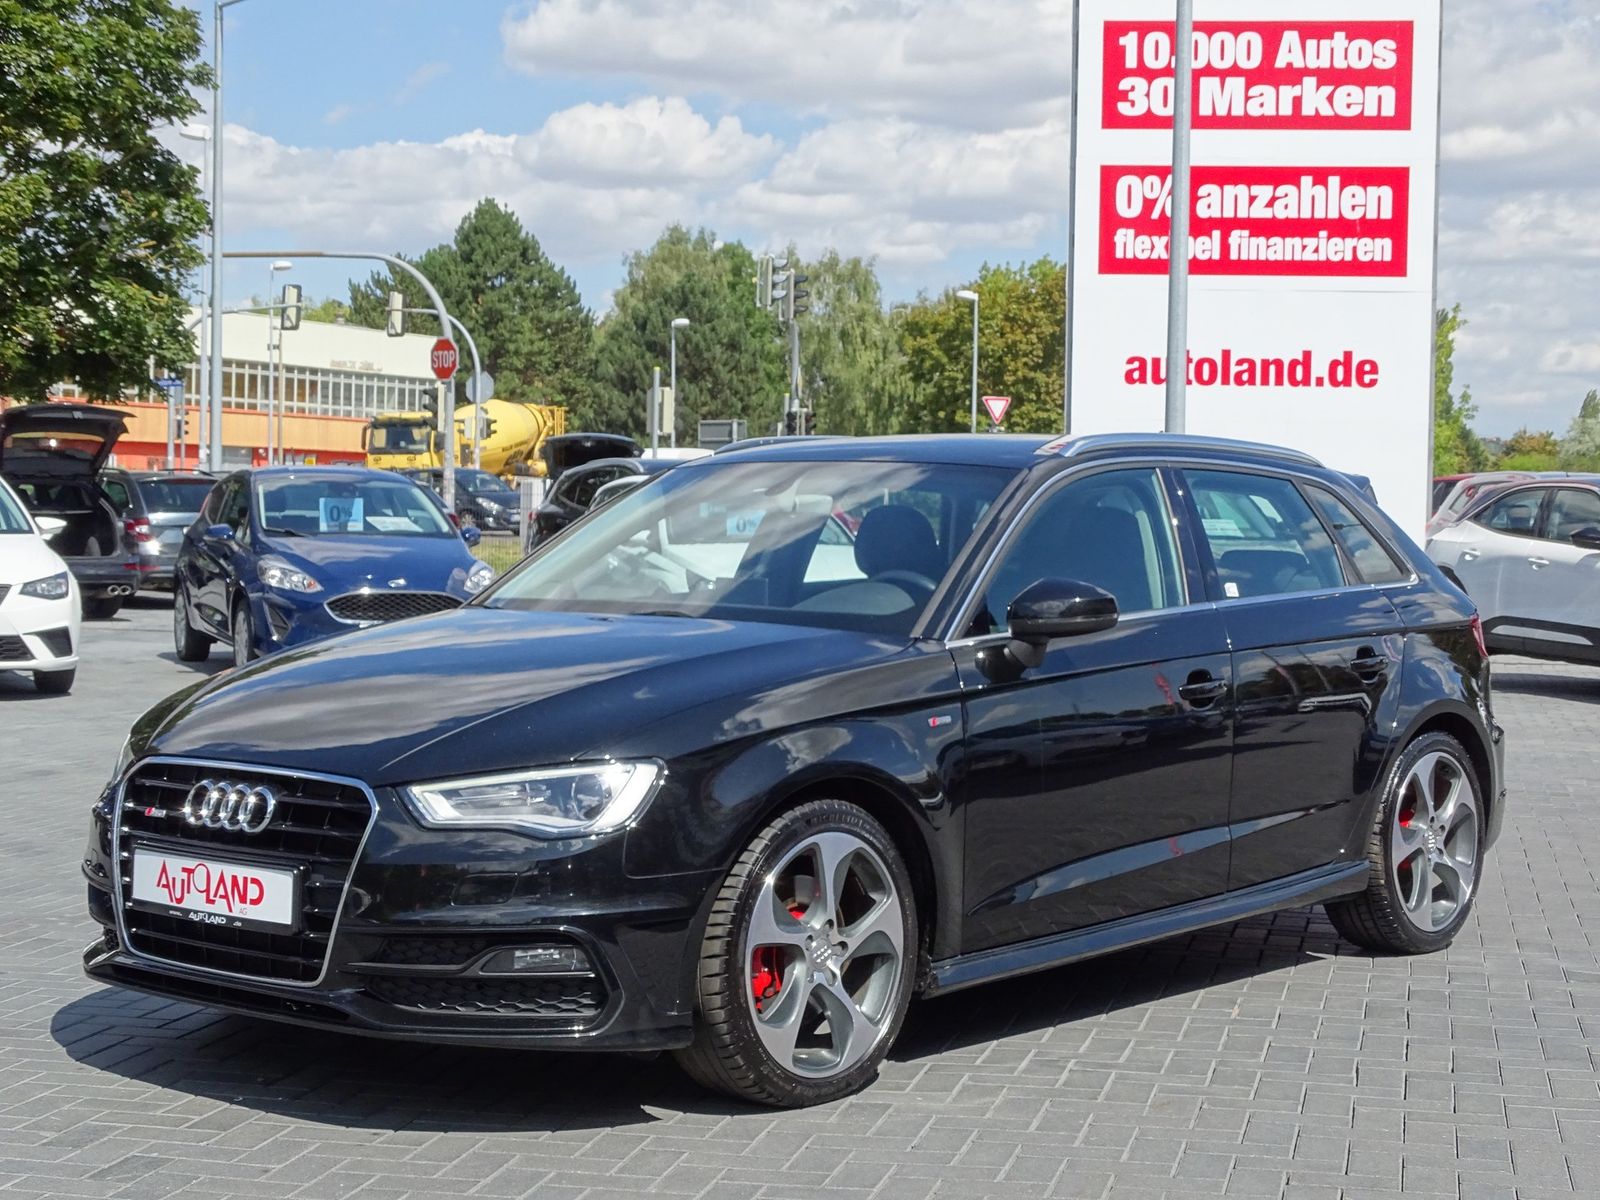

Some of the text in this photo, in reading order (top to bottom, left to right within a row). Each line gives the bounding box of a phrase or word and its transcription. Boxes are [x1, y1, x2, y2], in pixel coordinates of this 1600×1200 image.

[1273, 30, 1397, 70] Autos
[1116, 75, 1396, 117] 30 Marken
[1115, 174, 1393, 220] 0% anzahlen
[1113, 227, 1392, 262] flexel finanzieren
[432, 350, 455, 368] STOP
[156, 859, 264, 912] AUTOLAND
[188, 911, 226, 925] AUTOLAND
